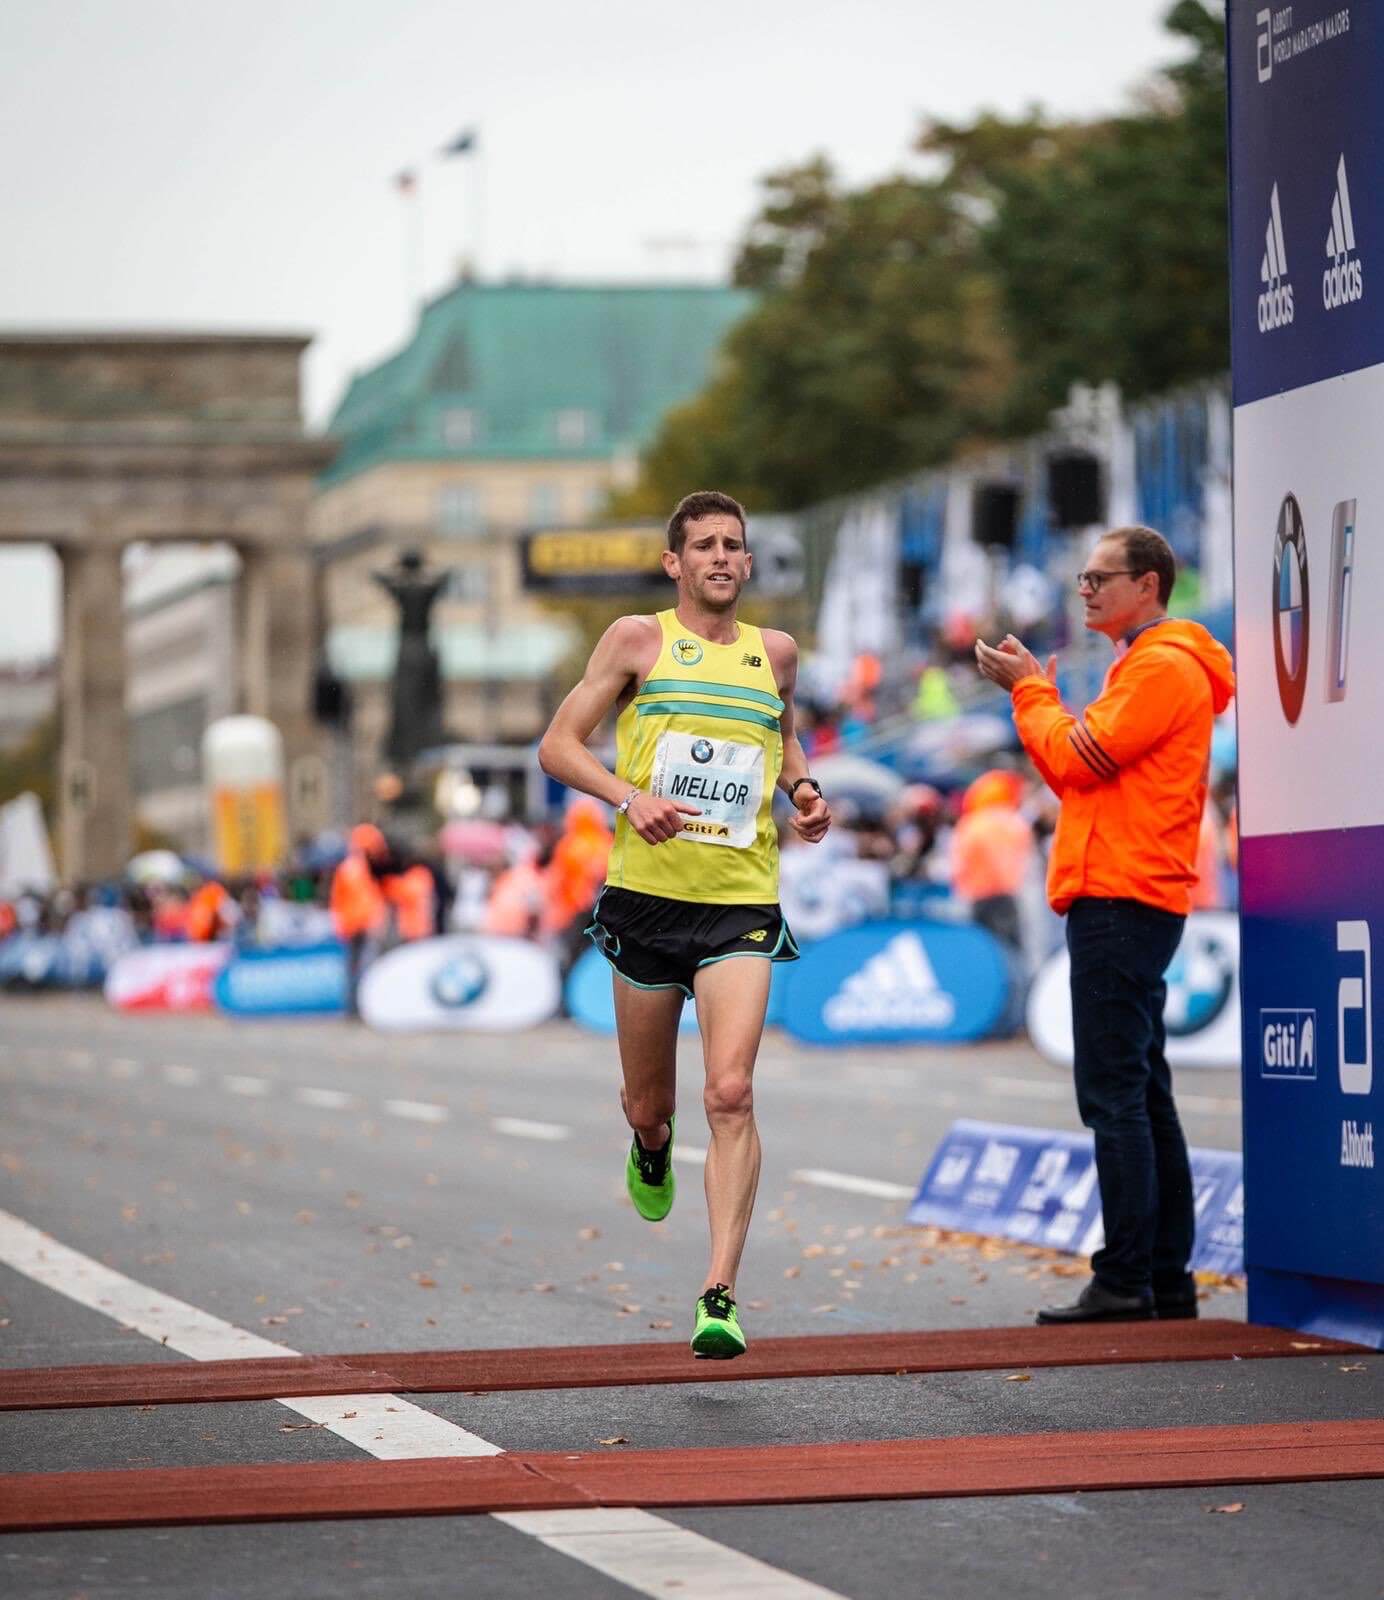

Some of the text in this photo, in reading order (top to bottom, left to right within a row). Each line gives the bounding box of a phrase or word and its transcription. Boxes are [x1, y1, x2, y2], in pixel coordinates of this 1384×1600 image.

[1273, 8, 1349, 64] WORLD MARATHON MAJORS
[1257, 277, 1294, 333] adidas
[1323, 250, 1363, 311] adidas
[670, 774, 749, 806] MELLOR
[683, 822, 713, 834] Giti
[1263, 1022, 1296, 1068] Giti
[1340, 1119, 1375, 1169] Abbott
